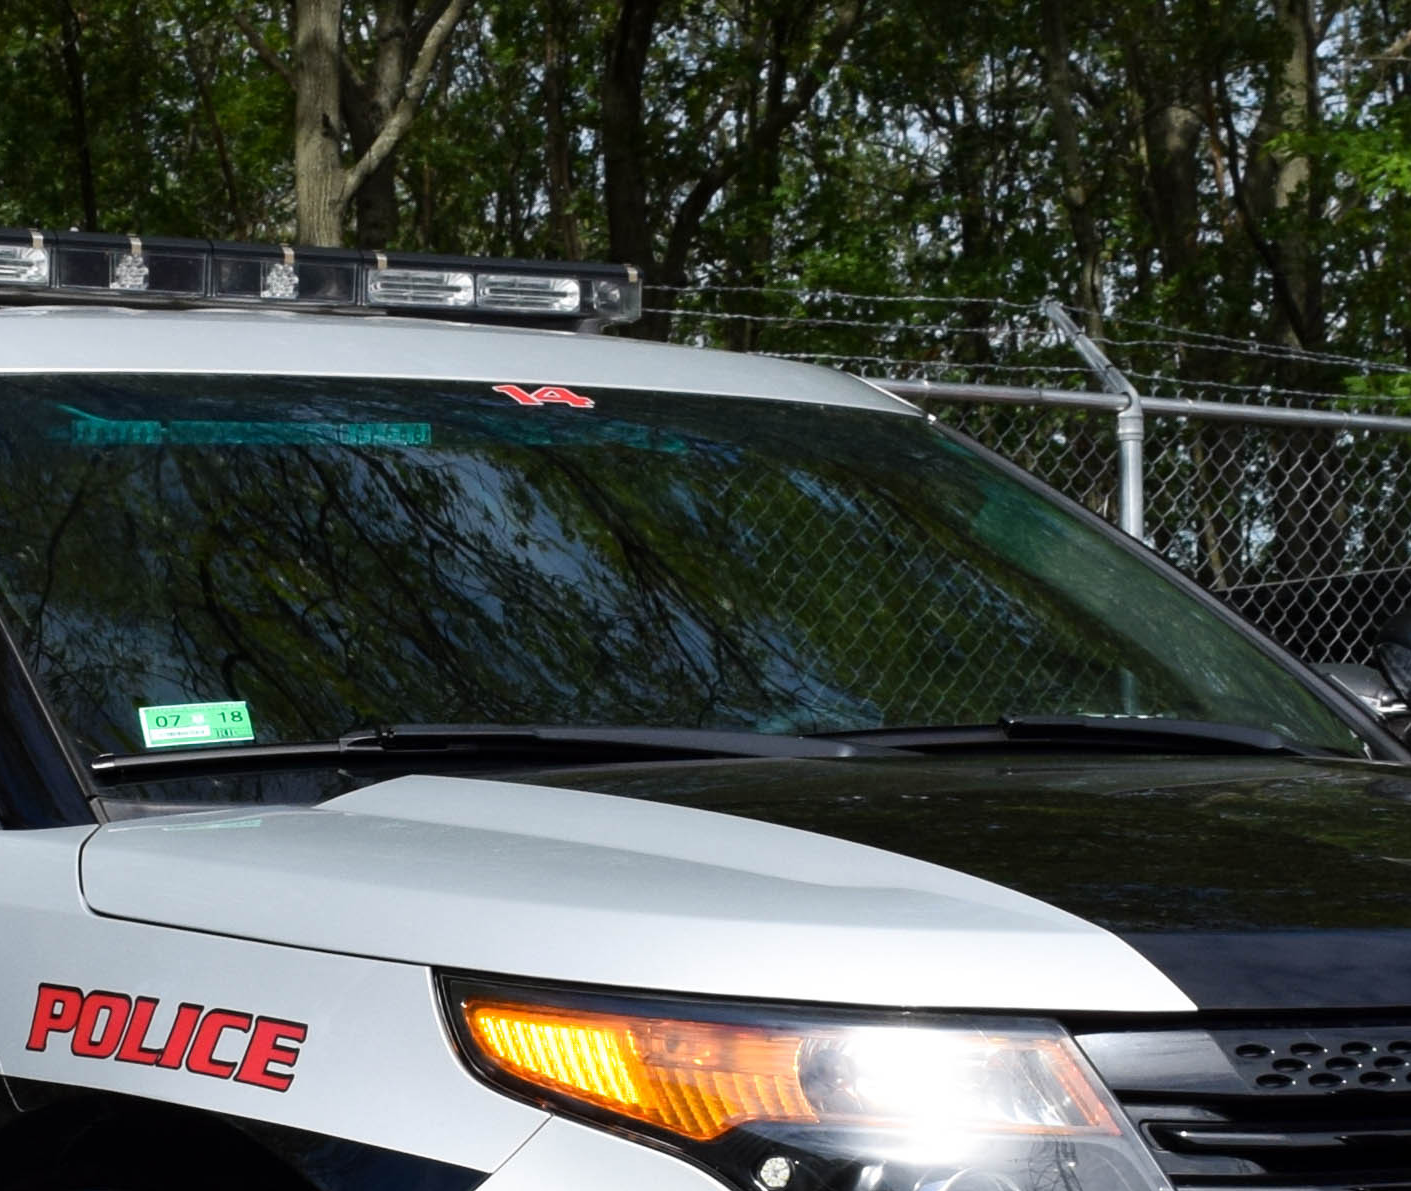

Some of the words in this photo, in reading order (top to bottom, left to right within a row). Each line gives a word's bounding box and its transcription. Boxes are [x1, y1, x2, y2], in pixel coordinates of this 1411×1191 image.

[492, 385, 595, 408] 14
[155, 715, 181, 728] 07
[219, 711, 244, 724] 18
[25, 982, 308, 1093] POLICE
